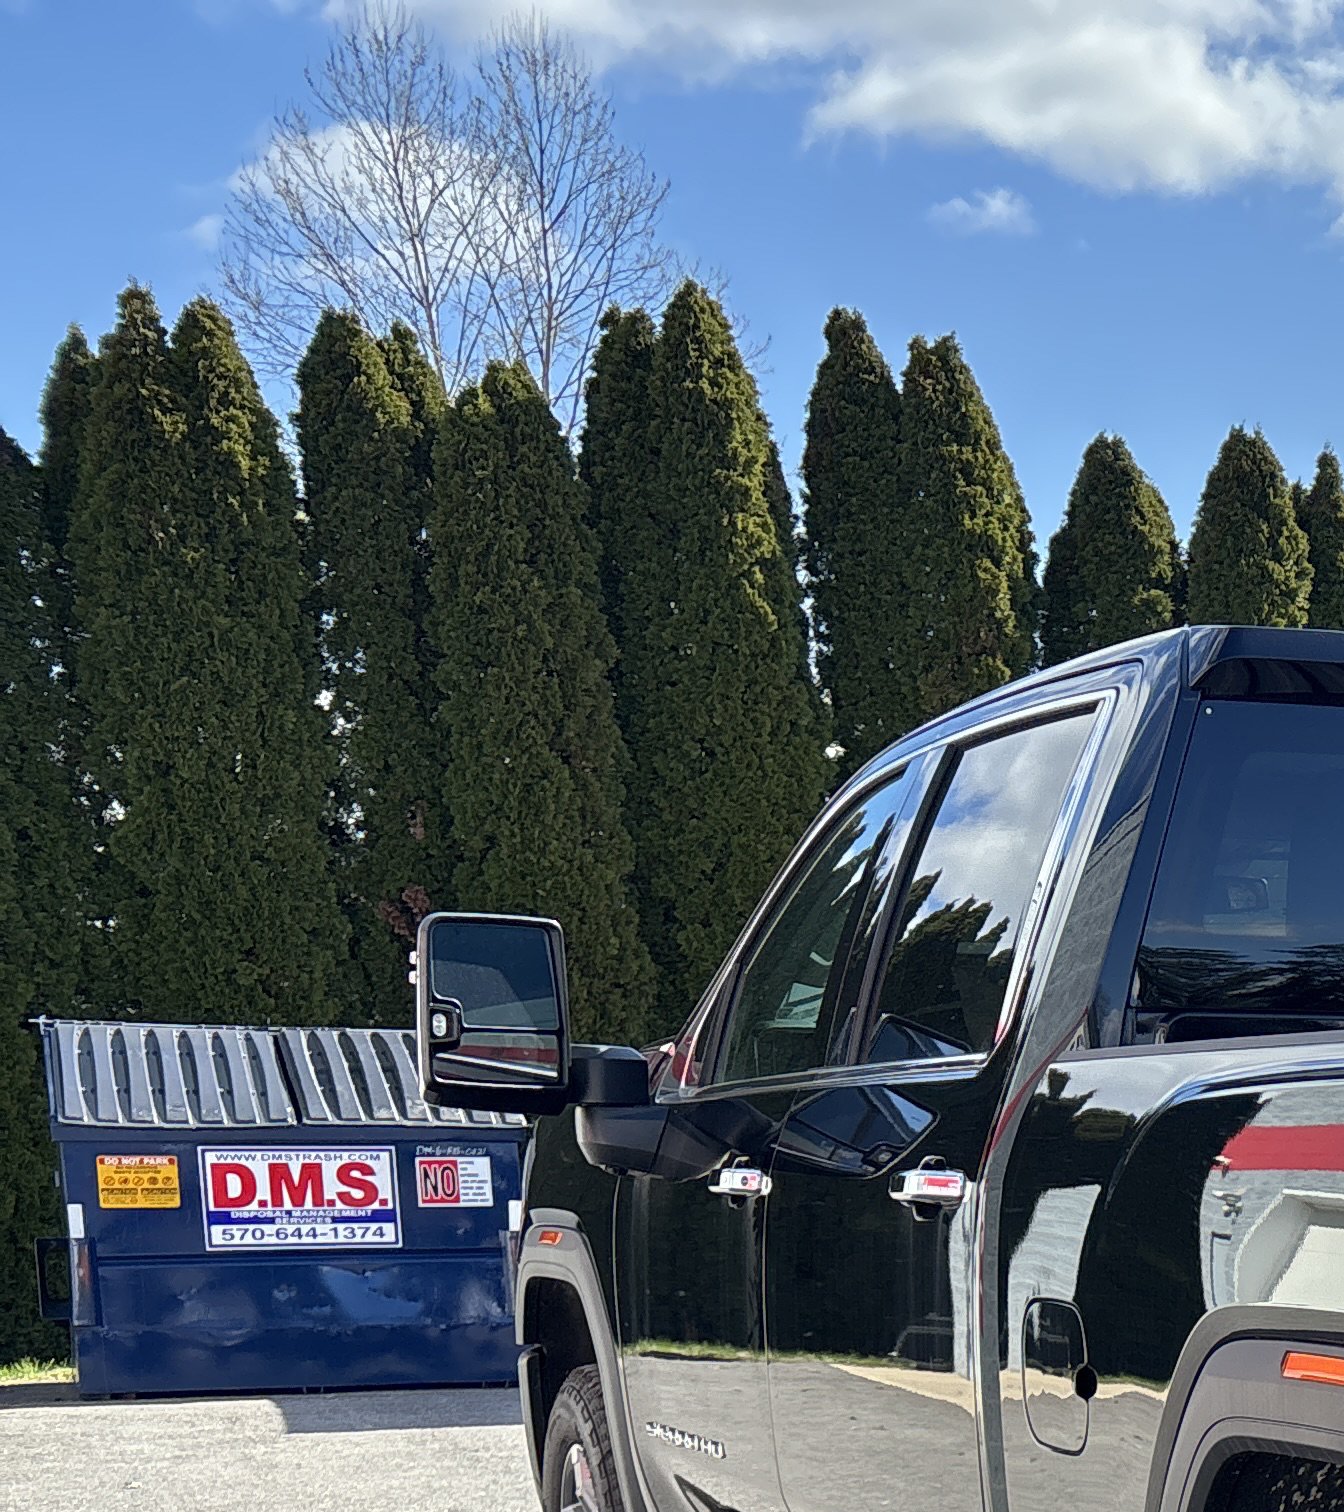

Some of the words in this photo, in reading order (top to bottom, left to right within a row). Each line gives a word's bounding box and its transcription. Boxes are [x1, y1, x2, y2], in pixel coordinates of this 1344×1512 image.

[214, 1153, 381, 1162] WWW.DMSTRASH.COM
[210, 1162, 389, 1208] D.M.S.
[420, 1163, 459, 1200] NO
[230, 1210, 288, 1219] DISPOSAL
[291, 1209, 373, 1217] MANAGEMENT
[274, 1217, 333, 1225] SERVICES
[221, 1226, 386, 1241] 570-644-1374
